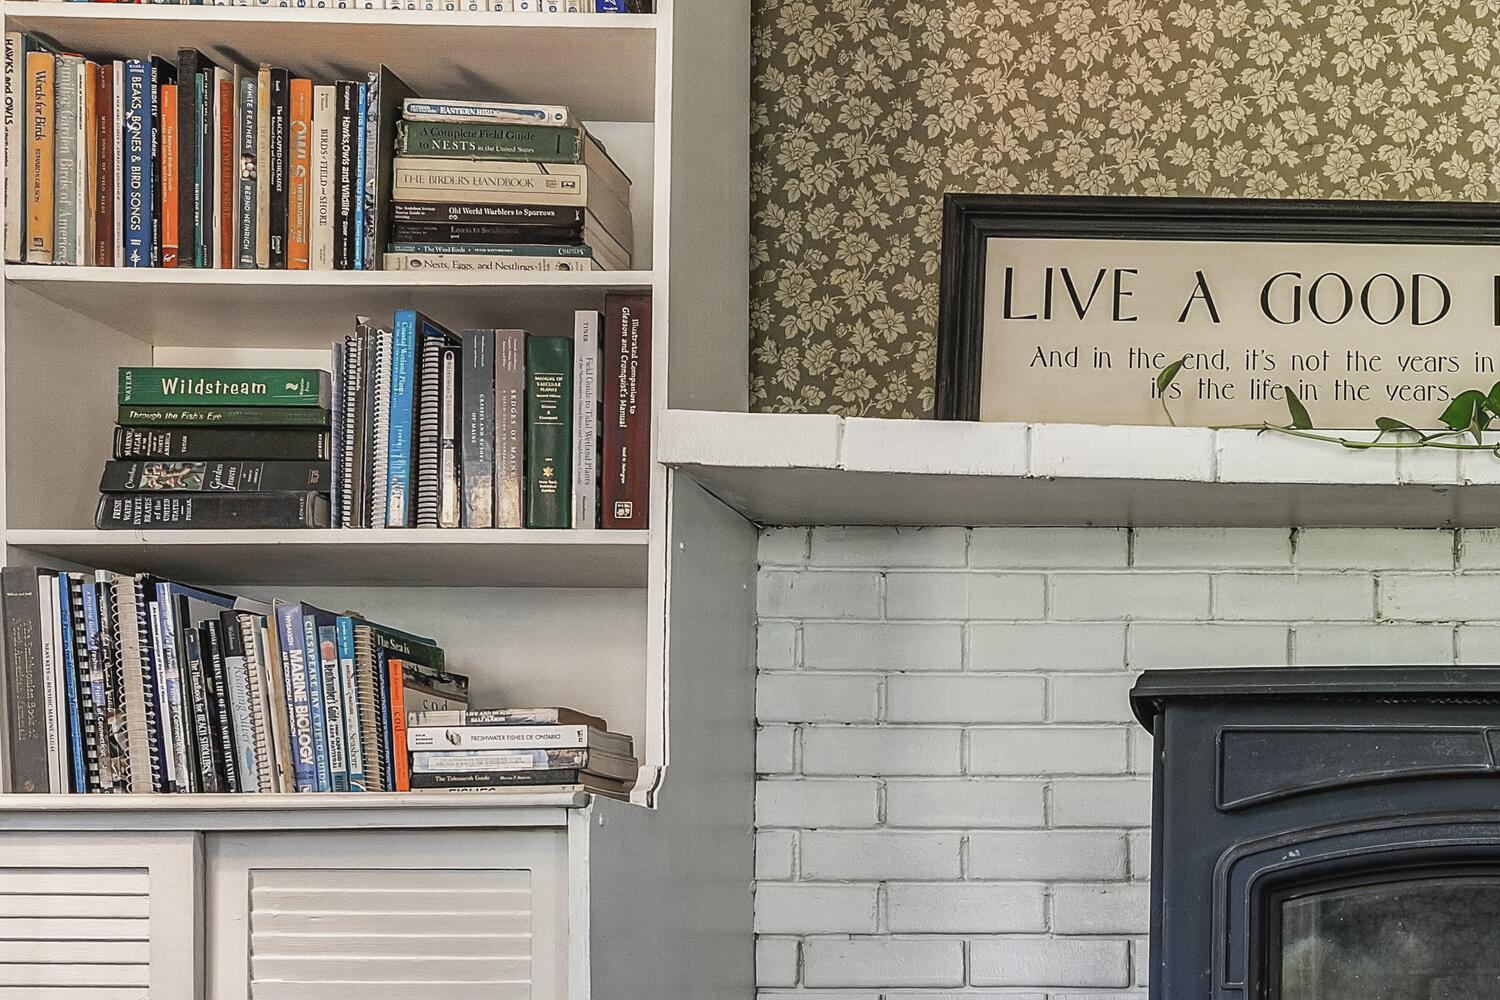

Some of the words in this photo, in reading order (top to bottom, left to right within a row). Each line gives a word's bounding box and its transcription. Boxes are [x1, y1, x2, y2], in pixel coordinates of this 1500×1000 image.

[35, 70, 46, 100] Words
[35, 116, 46, 141] Birds
[130, 116, 142, 152] BONES
[245, 110, 253, 149] FEATHERS
[320, 129, 328, 154] BIRDS
[420, 128, 429, 136] A
[479, 128, 503, 138] Field
[506, 130, 536, 140] Guide
[419, 140, 429, 149] to
[432, 140, 476, 150] NESTS
[60, 158, 73, 189] Birds
[130, 166, 142, 188] BIRD
[341, 166, 350, 182] and
[404, 174, 424, 184] THE
[473, 176, 534, 188] HANDBOOK
[130, 192, 141, 230] SONGS
[320, 196, 328, 226] SHORE
[1003, 267, 1138, 322] LIVE
[1178, 270, 1221, 323] A
[1260, 271, 1451, 326] GOOD
[630, 318, 639, 358] Illustrated
[1030, 346, 1078, 368] And
[1093, 346, 1112, 368] in
[1128, 348, 1166, 369] the
[1183, 349, 1230, 372] end,
[1245, 349, 1276, 370] it's
[1291, 350, 1330, 372] not
[1346, 350, 1382, 372] the
[1398, 352, 1460, 373] years
[1474, 352, 1494, 372] in
[162, 378, 267, 395] Wildstream
[628, 360, 638, 403] Companion
[1151, 378, 1182, 399] is
[1198, 378, 1235, 400] the
[1250, 378, 1284, 400] life
[1298, 380, 1318, 400] in
[1334, 380, 1370, 400] the
[1386, 381, 1455, 402] years.
[165, 411, 178, 420] the
[208, 412, 222, 421] Eye
[510, 429, 517, 441] OF
[290, 650, 308, 702] MARINE
[306, 621, 318, 686] CHESAPEAKE
[312, 690, 320, 708] BAY
[190, 660, 200, 670] The
[196, 704, 205, 712] for
[216, 682, 224, 697] LIFE
[218, 698, 226, 708] OF
[296, 706, 314, 765] BIOLOGY
